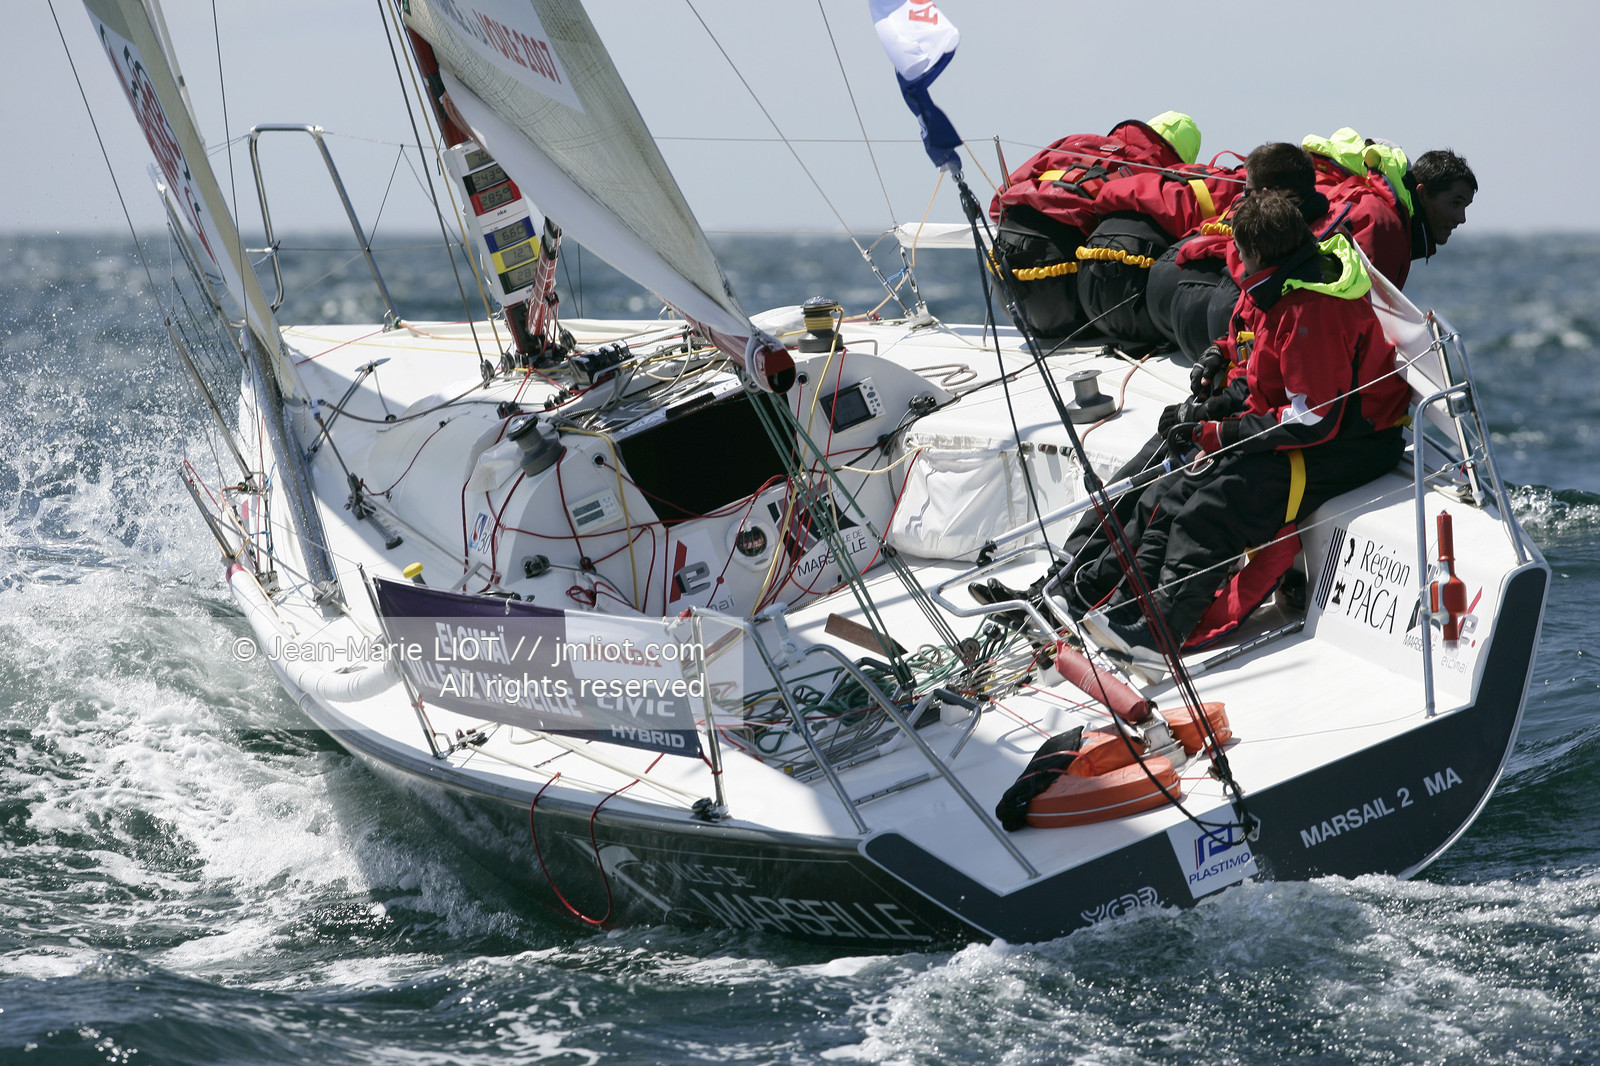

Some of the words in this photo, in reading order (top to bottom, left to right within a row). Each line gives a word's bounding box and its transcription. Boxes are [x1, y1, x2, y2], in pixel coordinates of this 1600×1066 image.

[1360, 540, 1410, 588] Région
[1346, 579, 1399, 635] PACA
[610, 724, 685, 748] HYBRID
[1300, 796, 1395, 849] MARSAIL
[1396, 787, 1414, 808] 2
[1423, 767, 1463, 798] MA
[712, 866, 756, 888] DE
[1188, 852, 1250, 885] PLASTIMO
[689, 888, 932, 941] MARSEILLE
